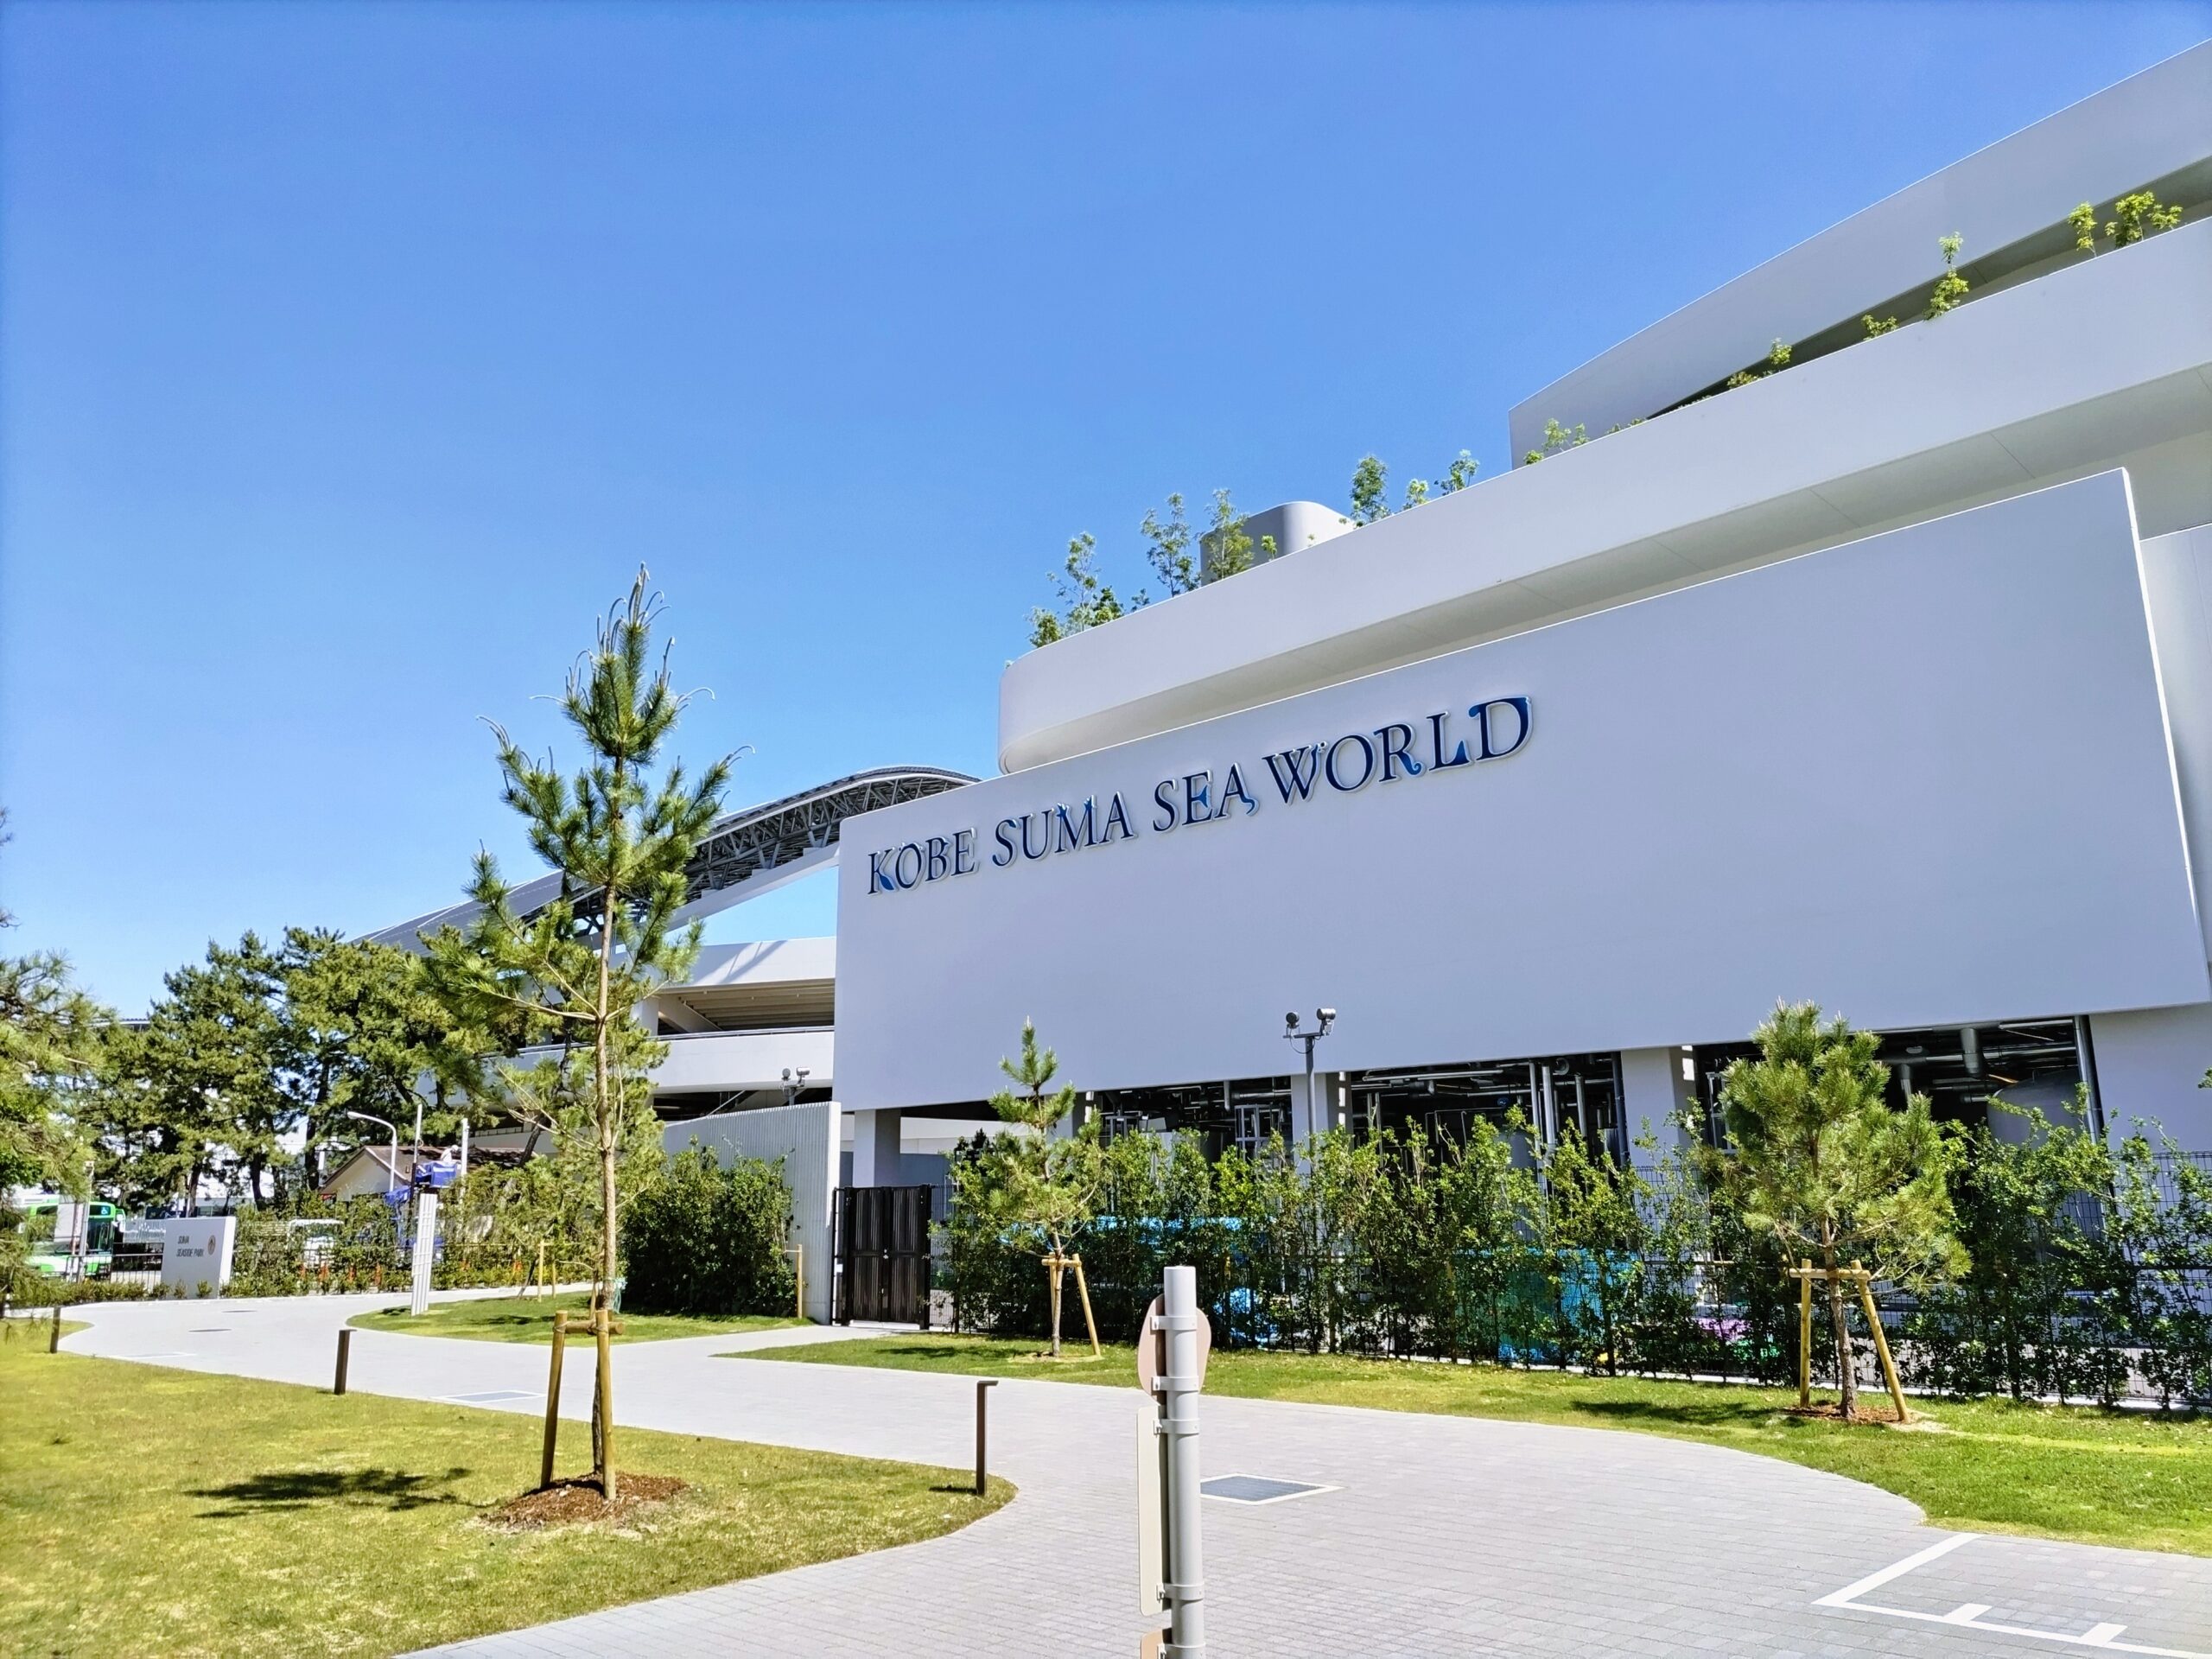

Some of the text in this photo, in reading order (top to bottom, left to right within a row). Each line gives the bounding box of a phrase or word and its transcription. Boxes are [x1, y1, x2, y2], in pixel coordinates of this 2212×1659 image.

[868, 696, 1534, 895] KOBE SUMA SEA WORLD
[178, 1236, 189, 1244] SUMA
[176, 1249, 204, 1257] SEASIDE PARK
